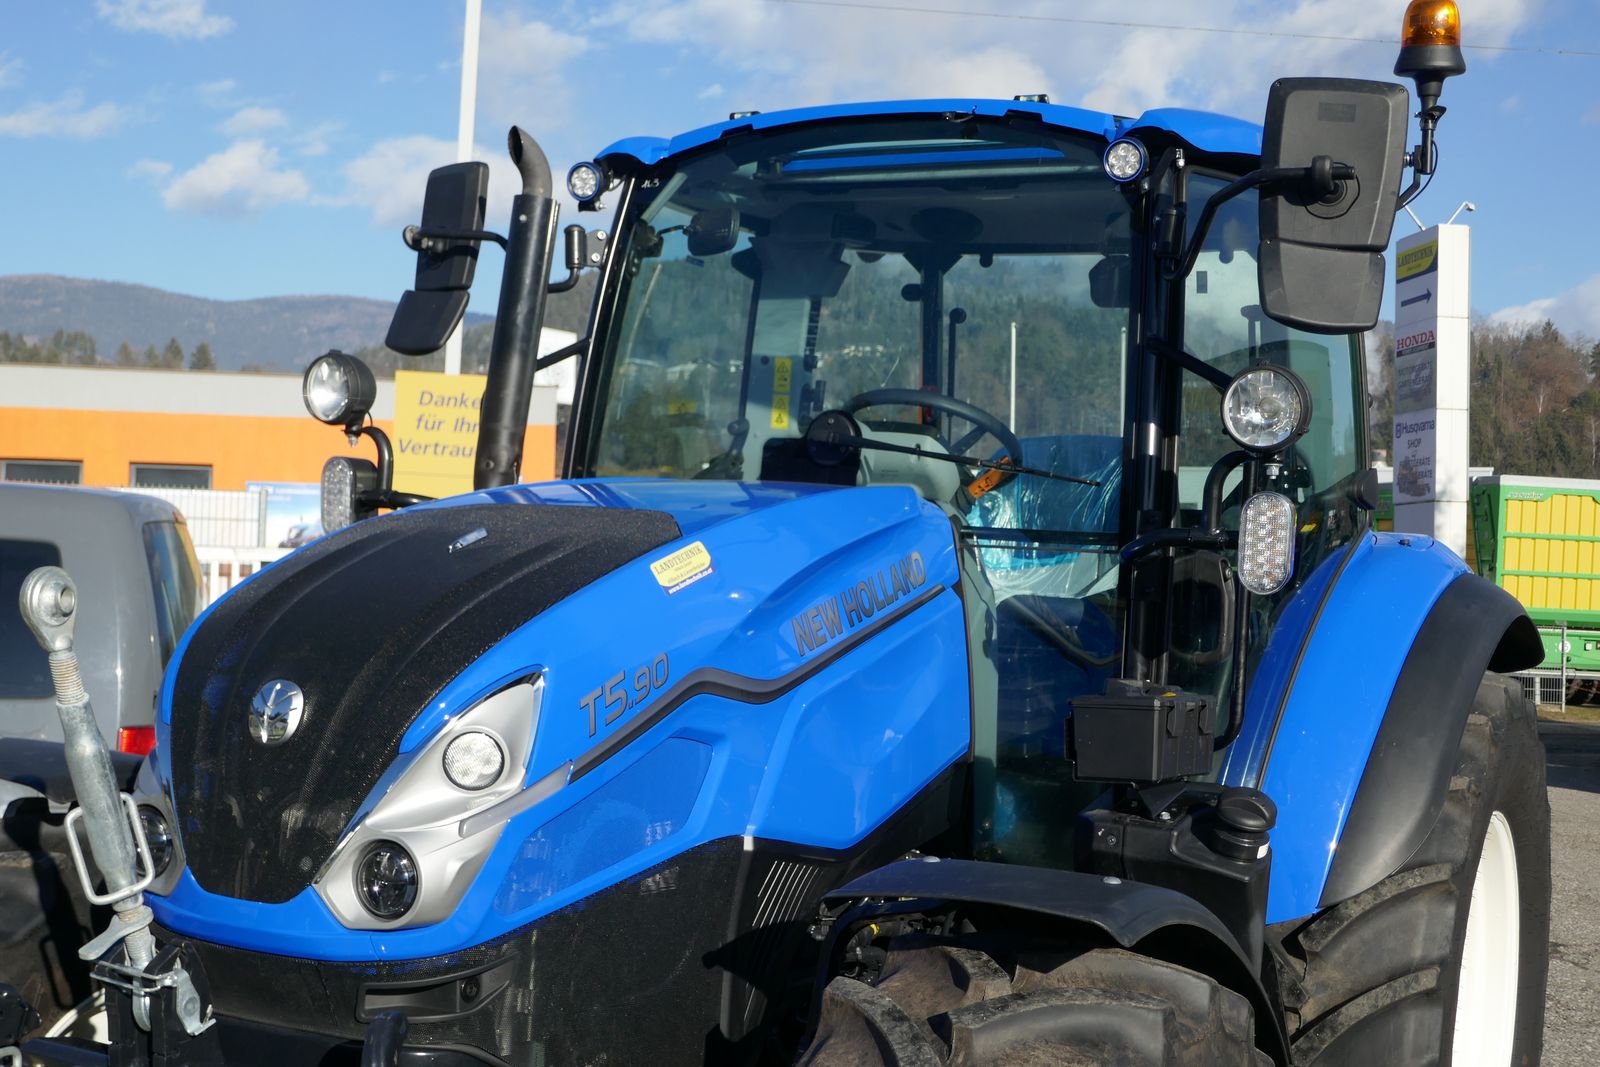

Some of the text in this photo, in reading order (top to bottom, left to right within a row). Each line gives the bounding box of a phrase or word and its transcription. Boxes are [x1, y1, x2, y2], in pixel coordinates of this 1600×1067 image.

[1397, 245, 1434, 266] LANDTECHNIK
[1396, 330, 1435, 349] HONDA
[419, 390, 481, 409] Danke
[416, 413, 445, 430] für
[1402, 420, 1435, 434] Husqvarna
[398, 437, 474, 457] Vertrau
[1407, 438, 1421, 449] SHOP
[654, 545, 703, 574] LANDTECHNIK
[791, 550, 926, 657] NEW HOLLAND
[579, 652, 669, 738] T5.90
